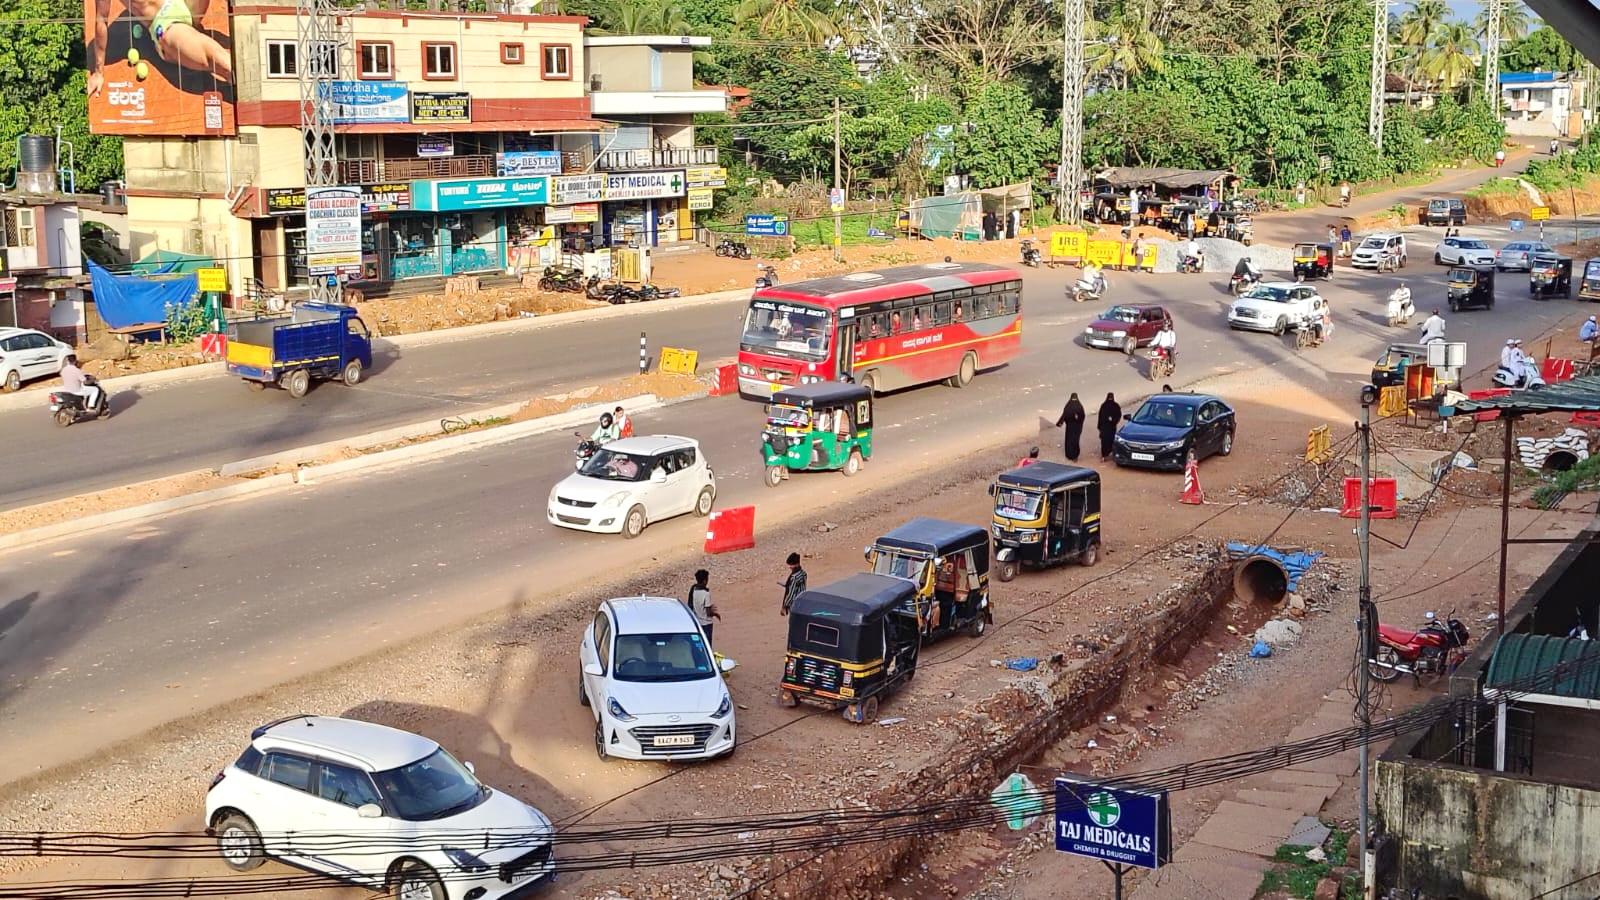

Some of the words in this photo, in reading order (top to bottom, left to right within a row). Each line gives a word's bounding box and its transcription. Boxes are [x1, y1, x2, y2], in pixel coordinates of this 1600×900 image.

[522, 157, 541, 166] BEST
[544, 156, 559, 166] FLY
[628, 174, 667, 187] MEDICAL
[374, 193, 400, 203] MART
[309, 200, 331, 209] GLOBAL
[332, 199, 358, 208] ACADEMY
[309, 209, 336, 219] COACHING
[337, 208, 358, 218] CLASSES
[1060, 820, 1081, 839] TAJ
[1084, 825, 1151, 853] MEDICALS
[1073, 843, 1100, 855] CHEMIST
[1100, 847, 1106, 855] &
[1106, 849, 1136, 862] DRUGGIST
